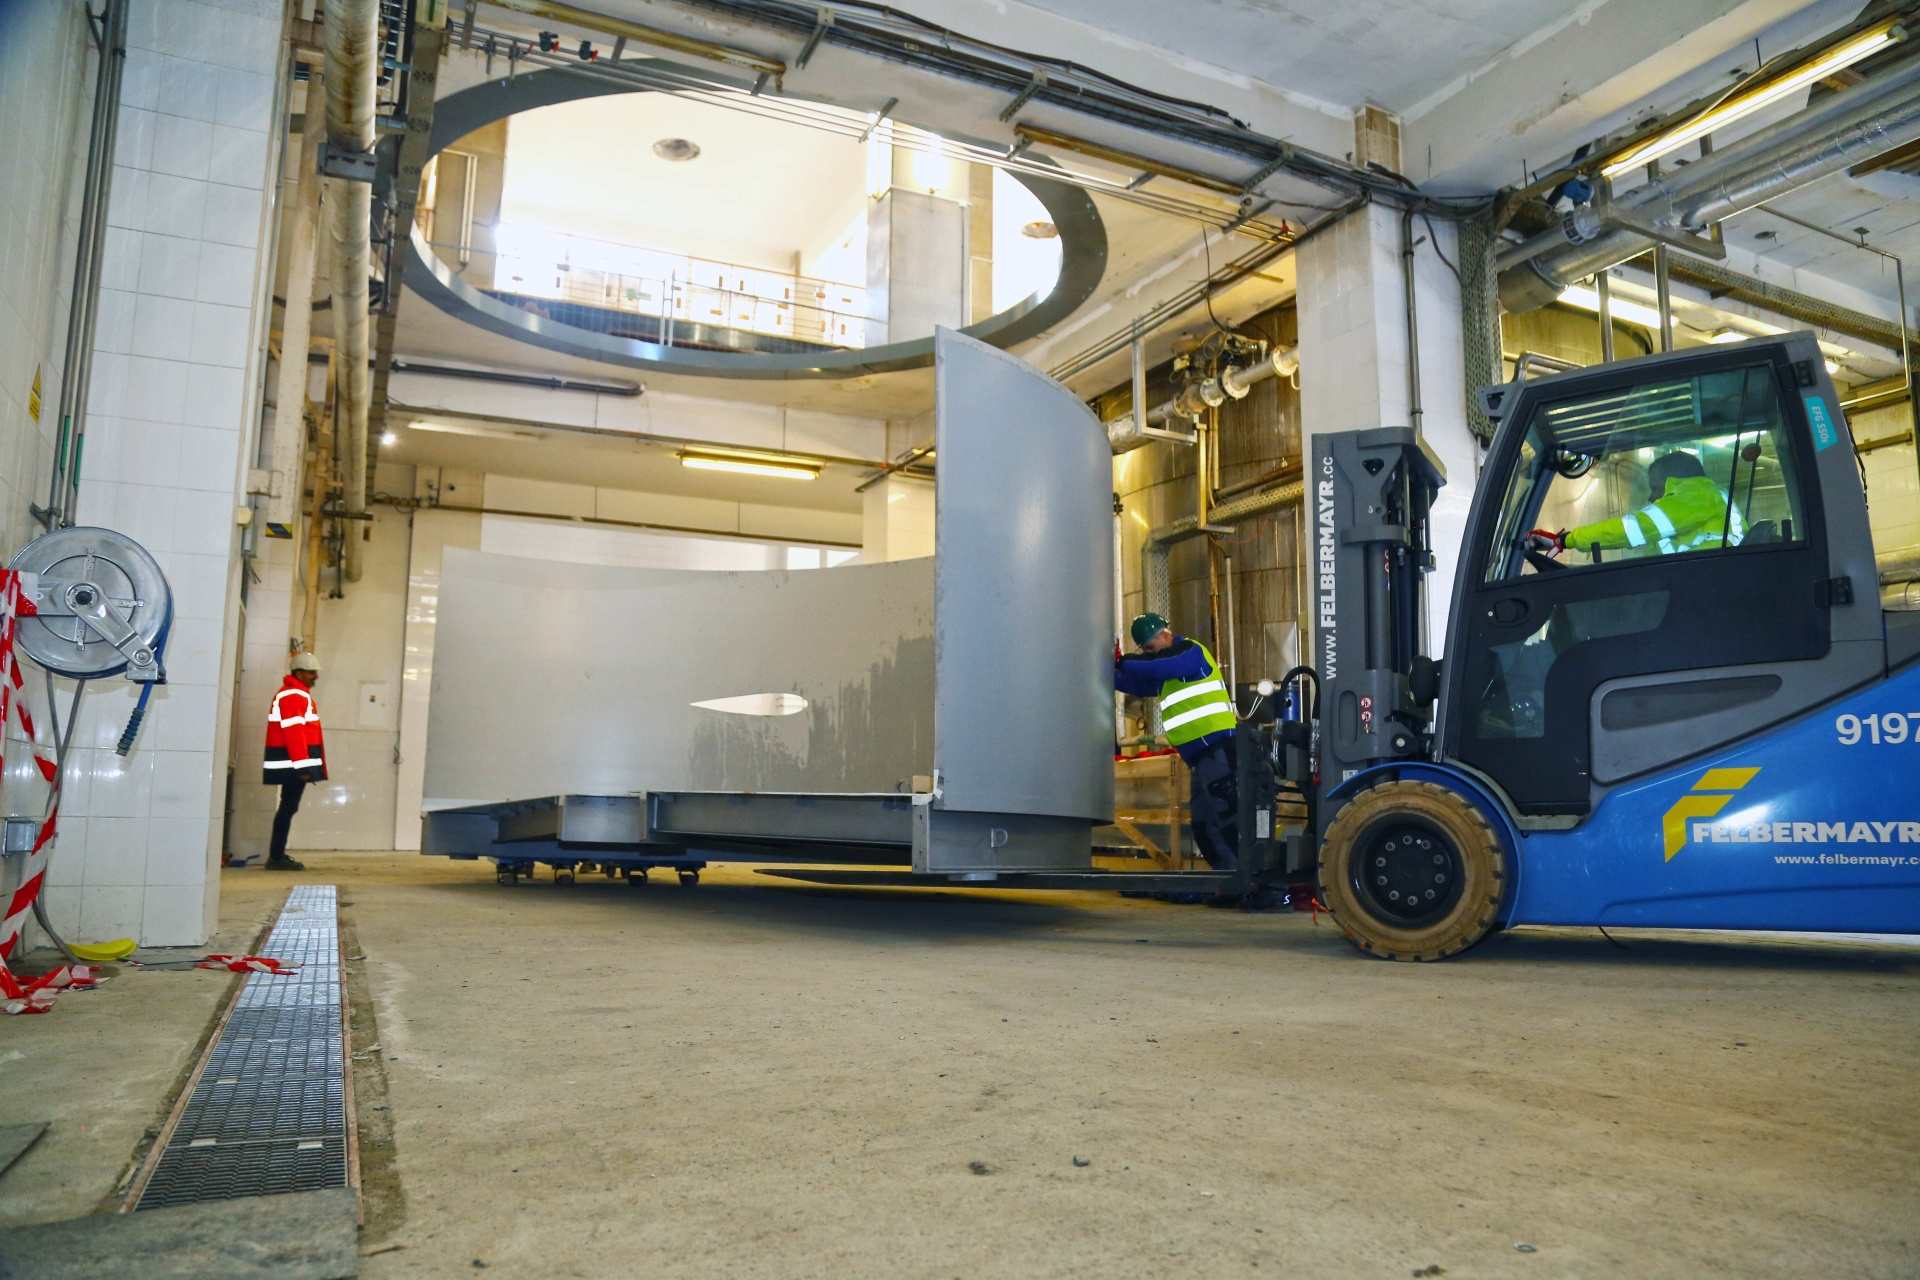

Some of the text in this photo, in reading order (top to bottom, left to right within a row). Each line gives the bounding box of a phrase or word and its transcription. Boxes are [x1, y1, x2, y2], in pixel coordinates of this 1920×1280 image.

[1319, 456, 1337, 680] www.FELBERMAYR.cc
[1692, 821, 1920, 843] FELBERMAYR
[1774, 853, 1920, 867] www.felbermayr.c
